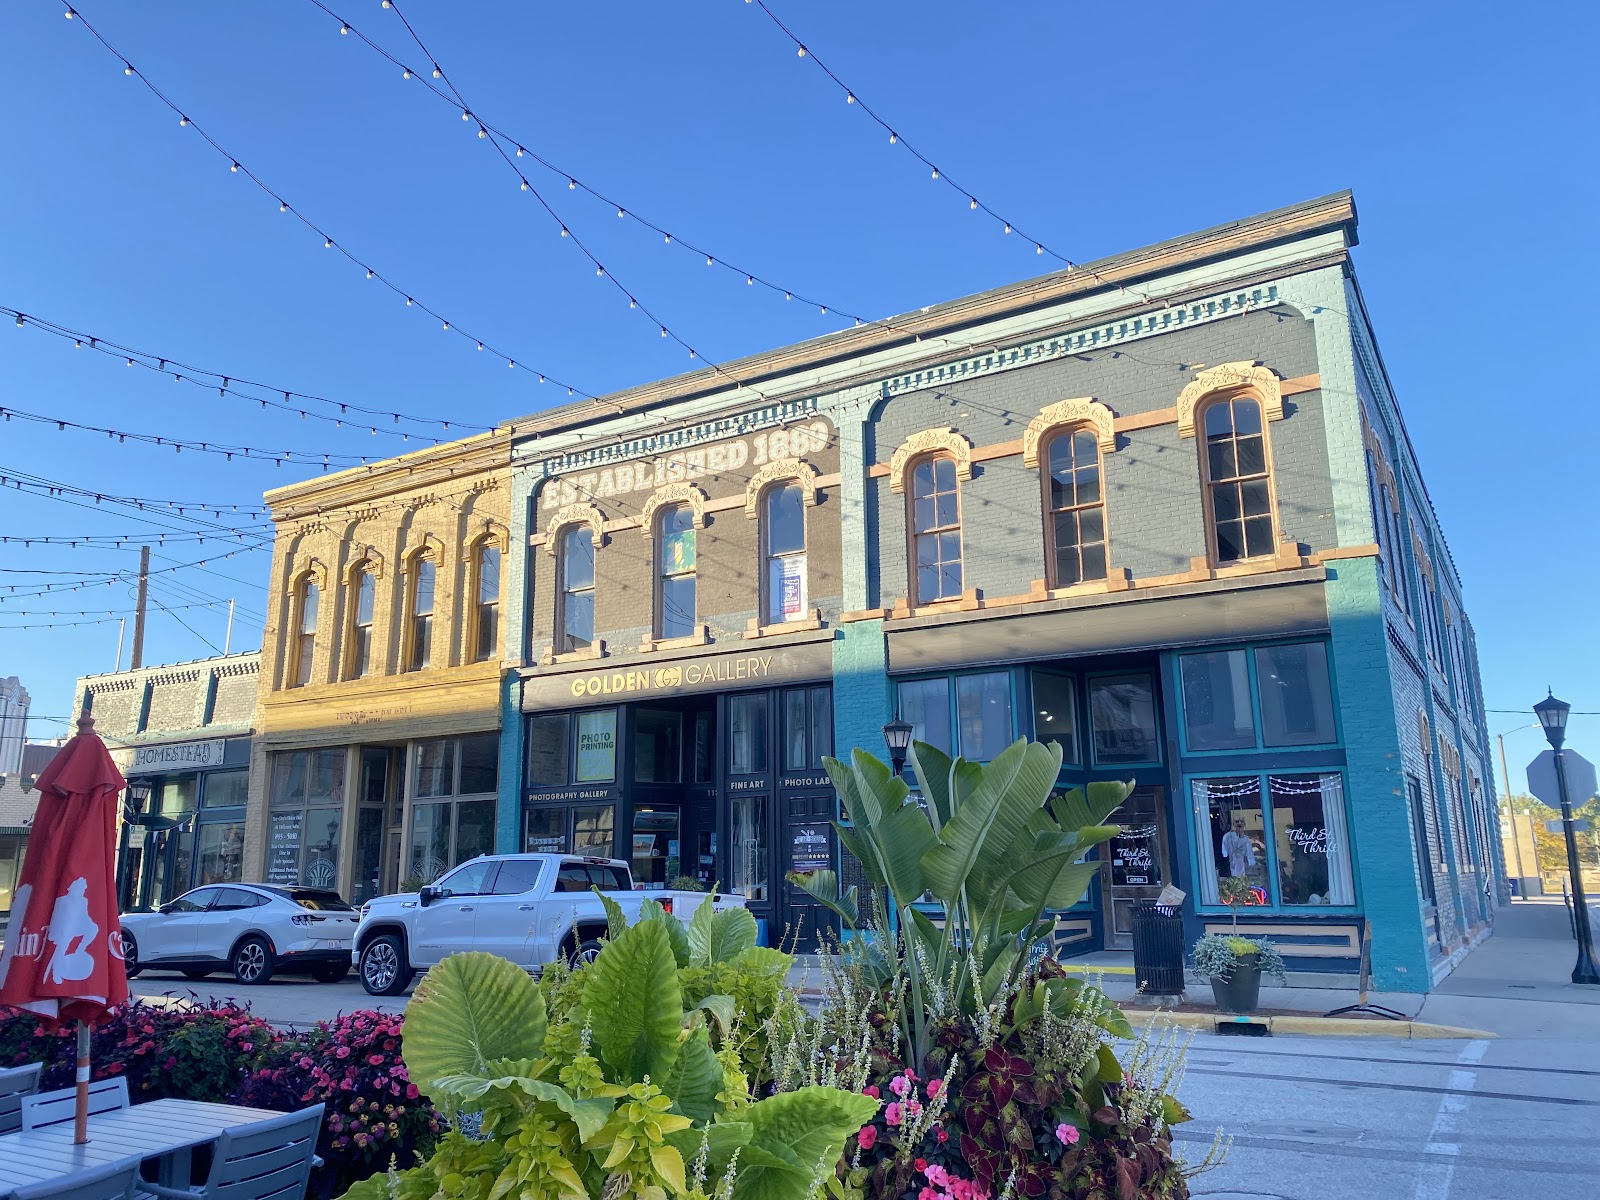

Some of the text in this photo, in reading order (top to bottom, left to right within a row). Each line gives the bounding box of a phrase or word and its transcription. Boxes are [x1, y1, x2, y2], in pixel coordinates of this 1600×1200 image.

[541, 421, 829, 509] ESTABLISHED 1889
[571, 670, 650, 697] GOLDEN
[686, 656, 773, 685] GALLERY
[581, 732, 611, 743] PHOTO
[580, 741, 614, 751] PRINTING
[135, 743, 211, 766] HOMESTEAD
[731, 780, 764, 790] FINE ART
[784, 778, 812, 787] PHOTO
[815, 776, 831, 785] LAB
[528, 790, 608, 801] PHOTOGRAPHY GALLERY
[1284, 827, 1318, 841] Third
[1116, 847, 1139, 858] Third
[1297, 840, 1338, 860] Thrift
[1125, 857, 1153, 870] Thrift
